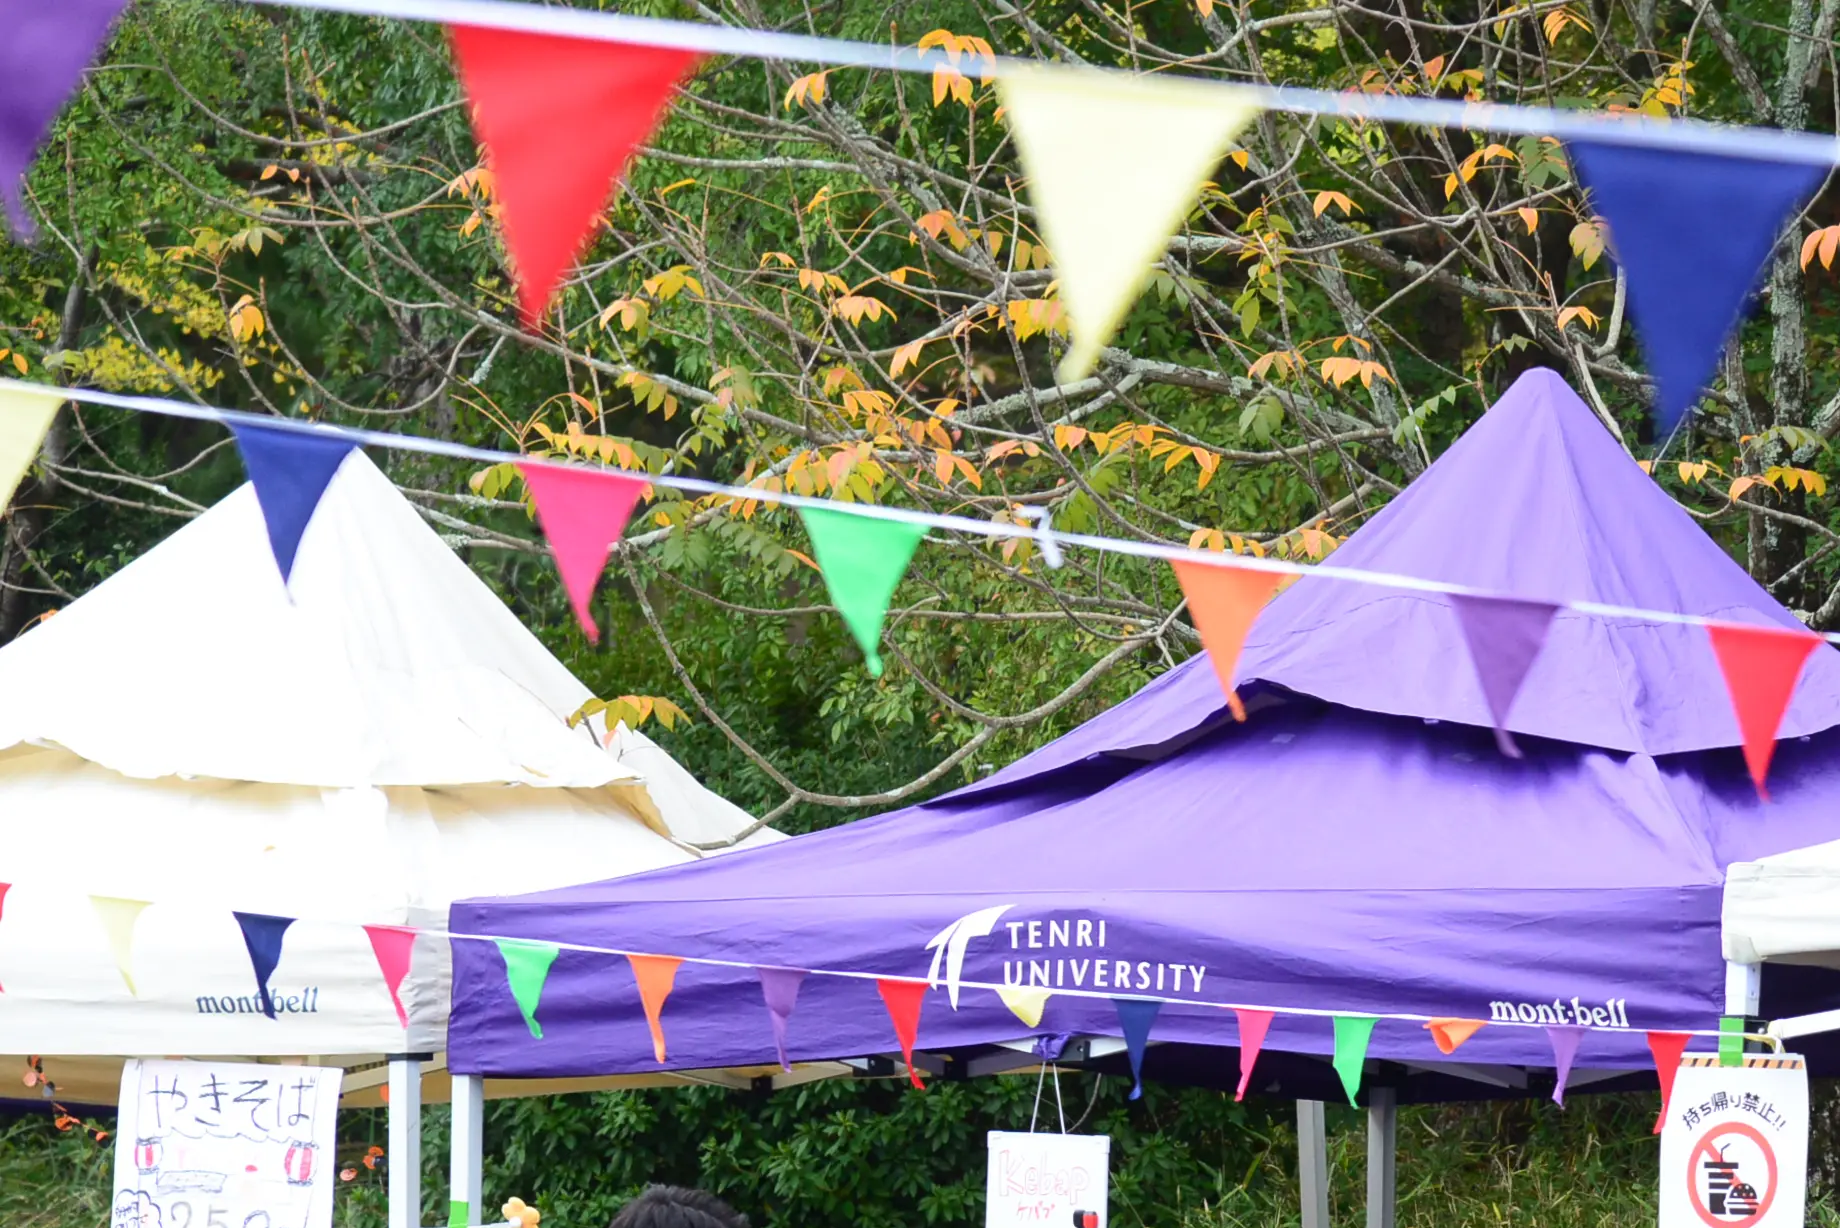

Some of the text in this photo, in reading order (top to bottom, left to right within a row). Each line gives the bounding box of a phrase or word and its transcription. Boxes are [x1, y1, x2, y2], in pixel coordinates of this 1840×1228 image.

[1005, 919, 1106, 949] TENRI
[1003, 958, 1206, 993] UNIVERSITY
[146, 1072, 317, 1133] やきそば
[999, 1148, 1090, 1206] Kebap
